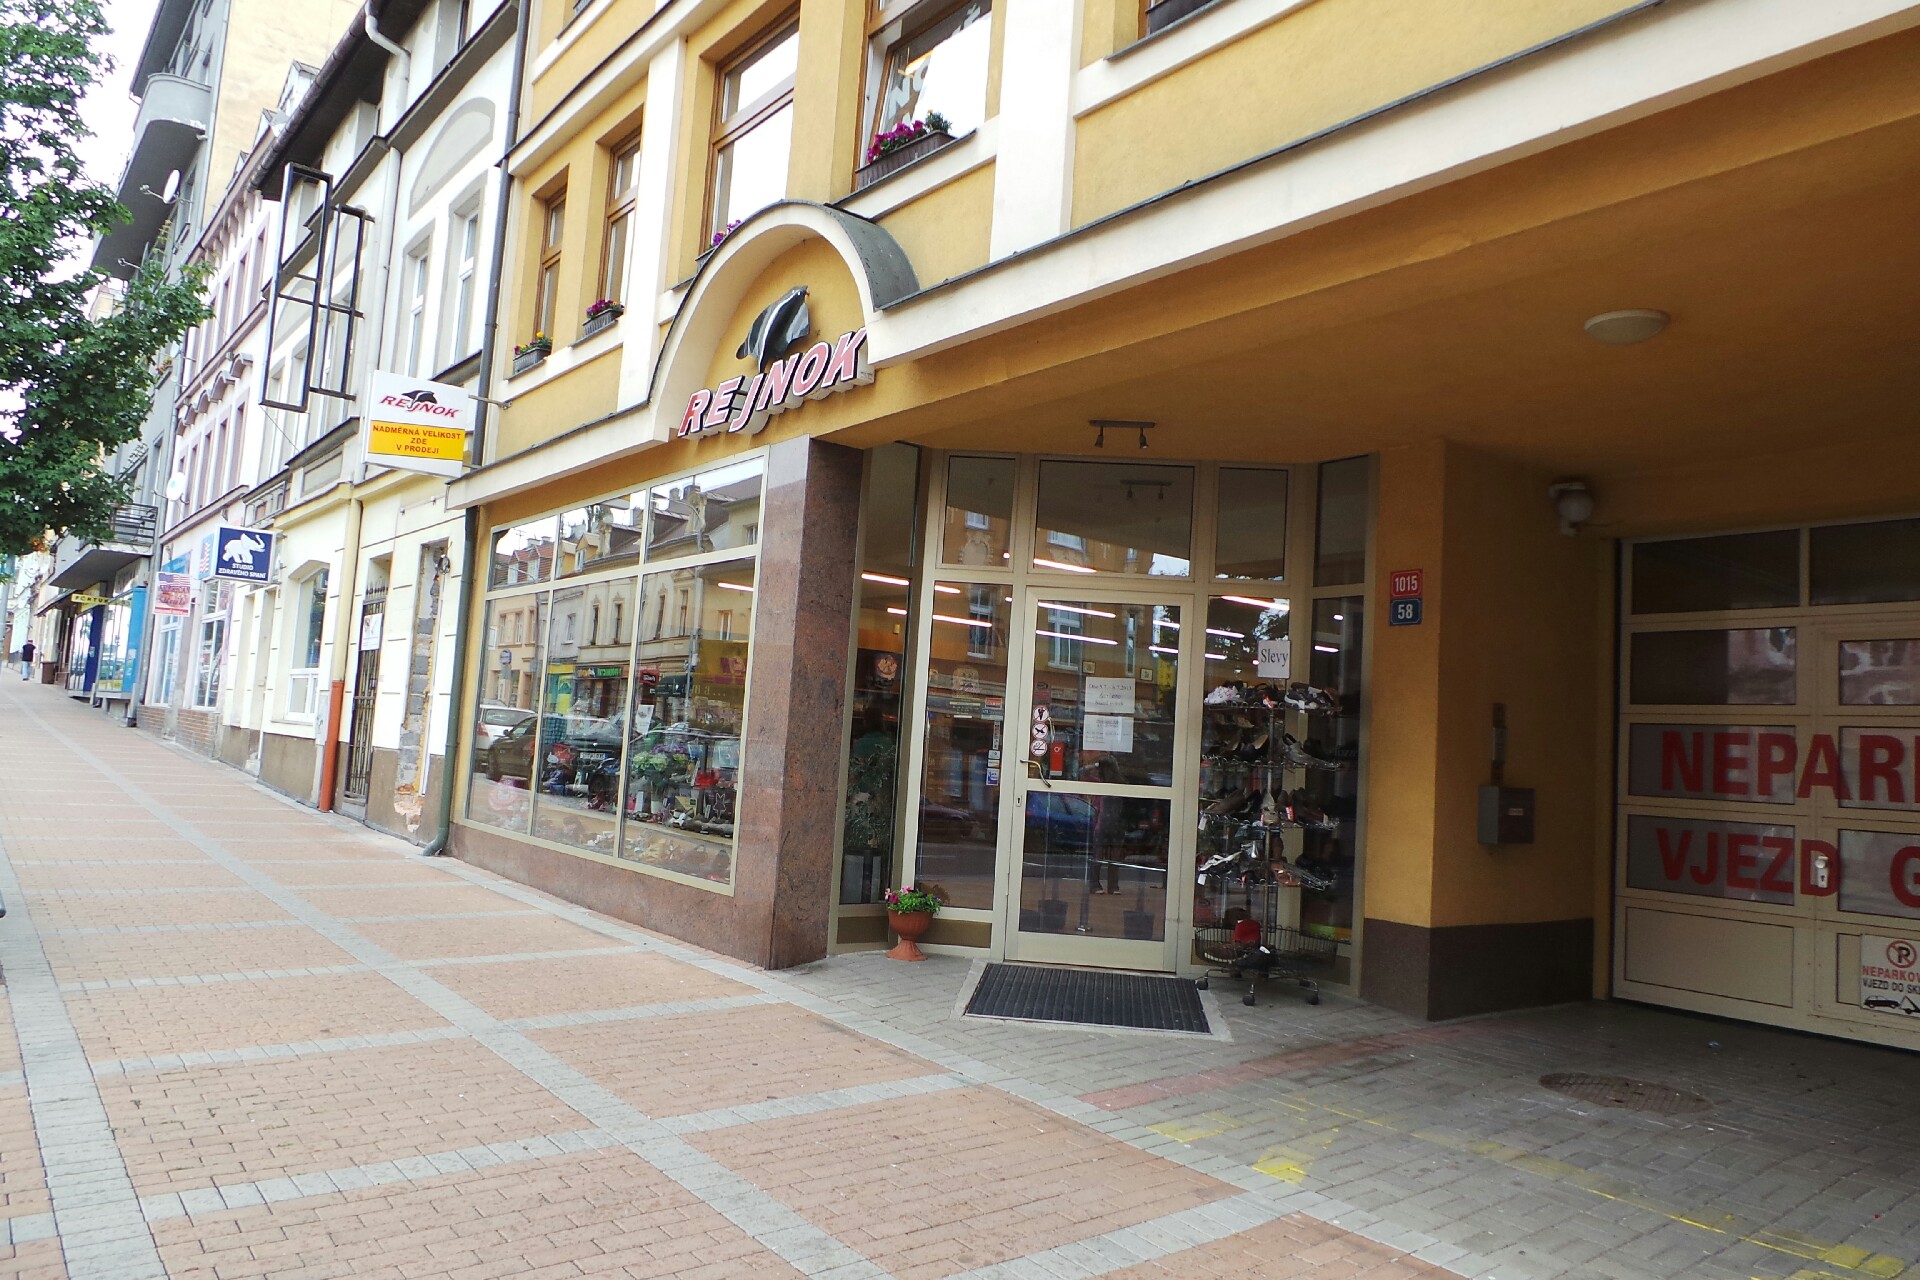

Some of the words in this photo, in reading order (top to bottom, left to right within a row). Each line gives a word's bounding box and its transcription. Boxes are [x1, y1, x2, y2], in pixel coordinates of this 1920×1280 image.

[677, 326, 868, 438] REJNOK
[380, 395, 460, 418] REJNOK
[410, 437, 427, 445] ZDE
[422, 430, 461, 440] VELIKOST
[404, 446, 439, 454] PRODEJI
[232, 563, 254, 571] STUDIO
[1394, 575, 1418, 592] 1015
[1397, 603, 1414, 620] 58
[1260, 648, 1289, 667] Slevy
[1661, 731, 1920, 804] NEPAR
[1656, 828, 1840, 897] VJEZD
[1862, 978, 1889, 990] VJEZD
[1891, 982, 1905, 993] DO
